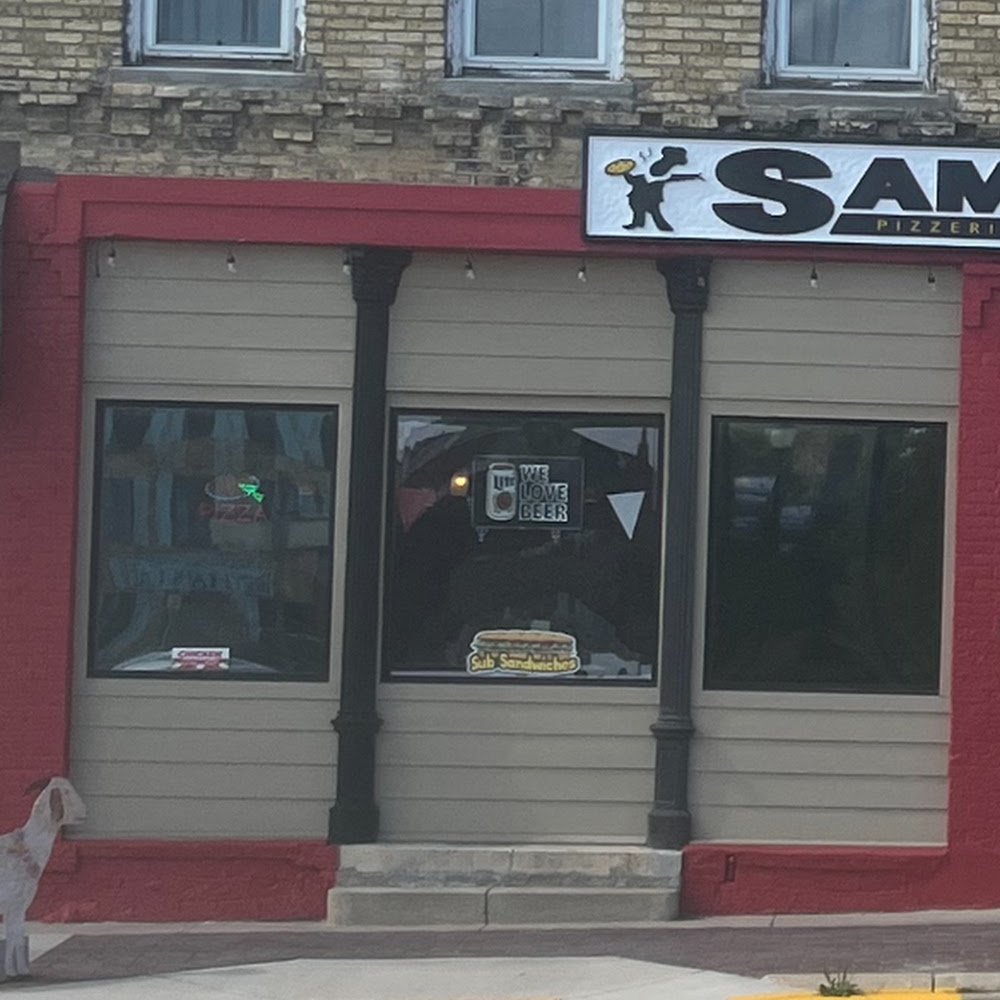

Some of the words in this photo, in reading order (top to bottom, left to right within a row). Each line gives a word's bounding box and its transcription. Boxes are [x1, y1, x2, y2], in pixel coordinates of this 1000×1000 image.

[520, 466, 549, 482] WE
[520, 483, 568, 502] LOVE
[199, 502, 269, 522] PIZZA
[520, 502, 568, 521] BEER
[471, 655, 495, 671] Sub
[499, 652, 577, 671] Sandwiches
